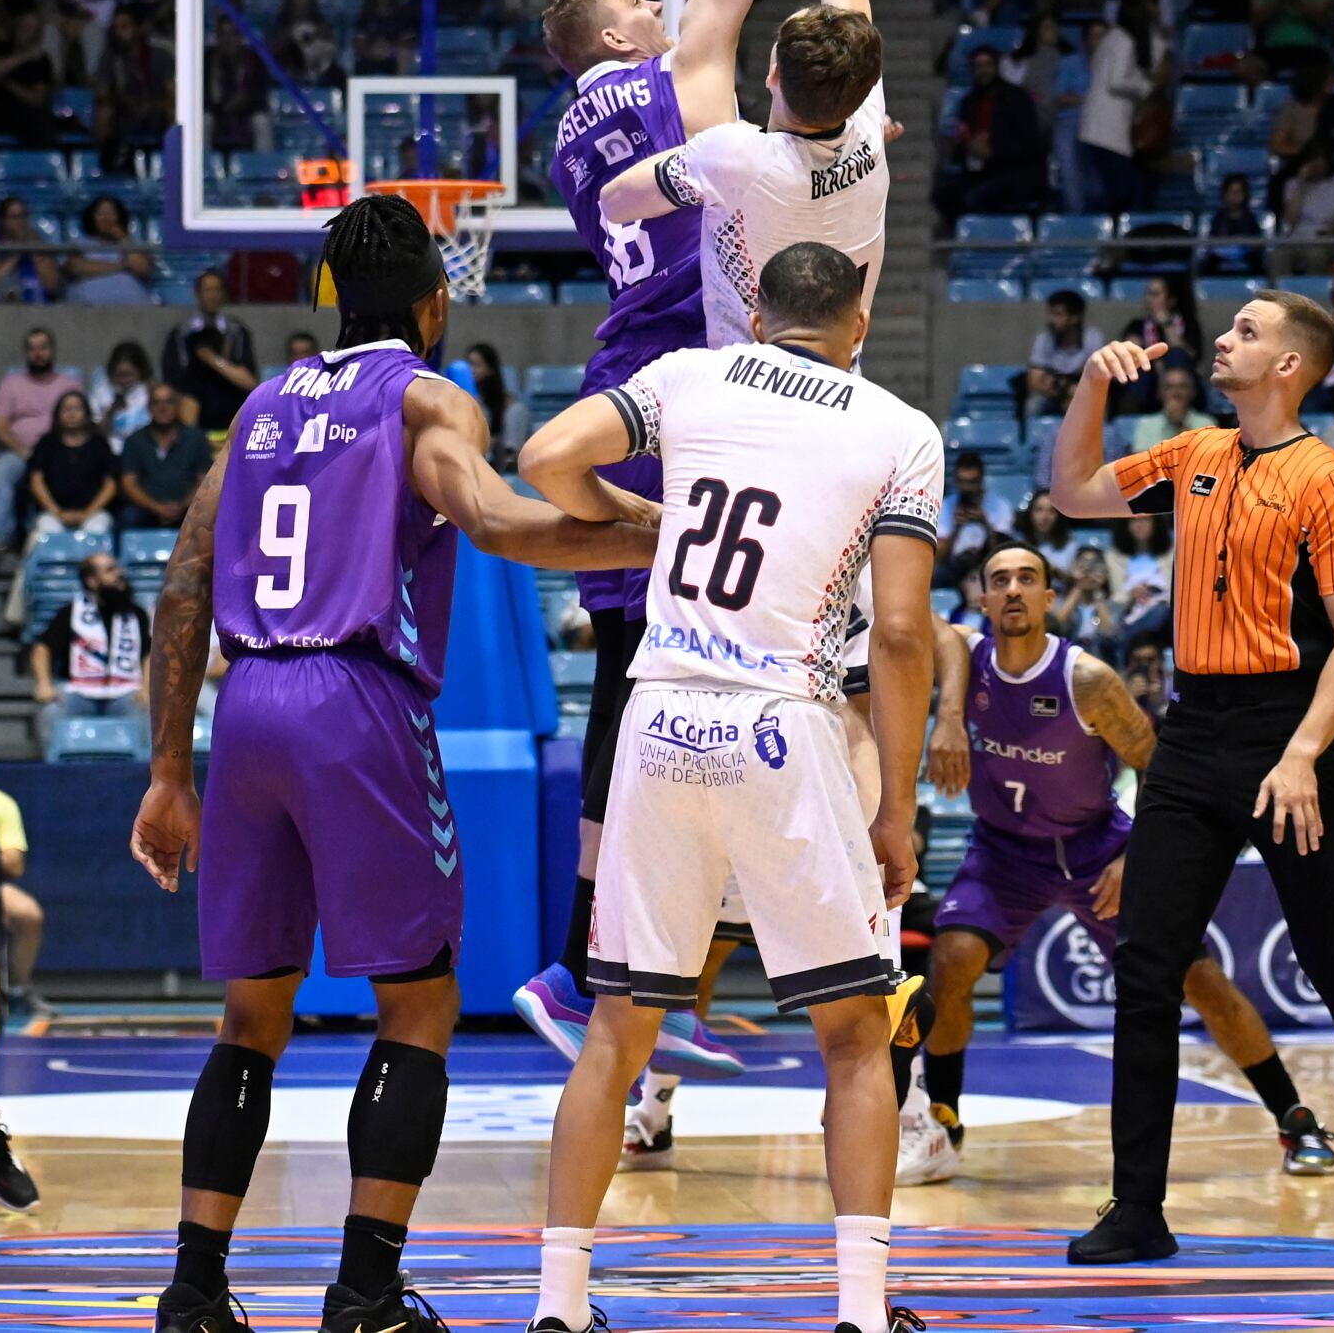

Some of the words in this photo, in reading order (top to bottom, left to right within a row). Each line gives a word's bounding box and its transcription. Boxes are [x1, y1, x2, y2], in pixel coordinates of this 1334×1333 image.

[725, 355, 854, 411] MENDOZA
[267, 430, 283, 440] LEN
[329, 424, 357, 443] Dip
[1255, 498, 1286, 513] SPALDING
[255, 485, 311, 610] 9
[669, 477, 782, 611] 26
[293, 632, 334, 648] LEÓN
[648, 709, 666, 733] A
[639, 741, 677, 765] UNHA
[983, 738, 1067, 766] zunder
[639, 759, 666, 780] POR
[1004, 780, 1026, 814] 7
[235, 1085, 248, 1110] HEX
[372, 1079, 386, 1103] HEX
